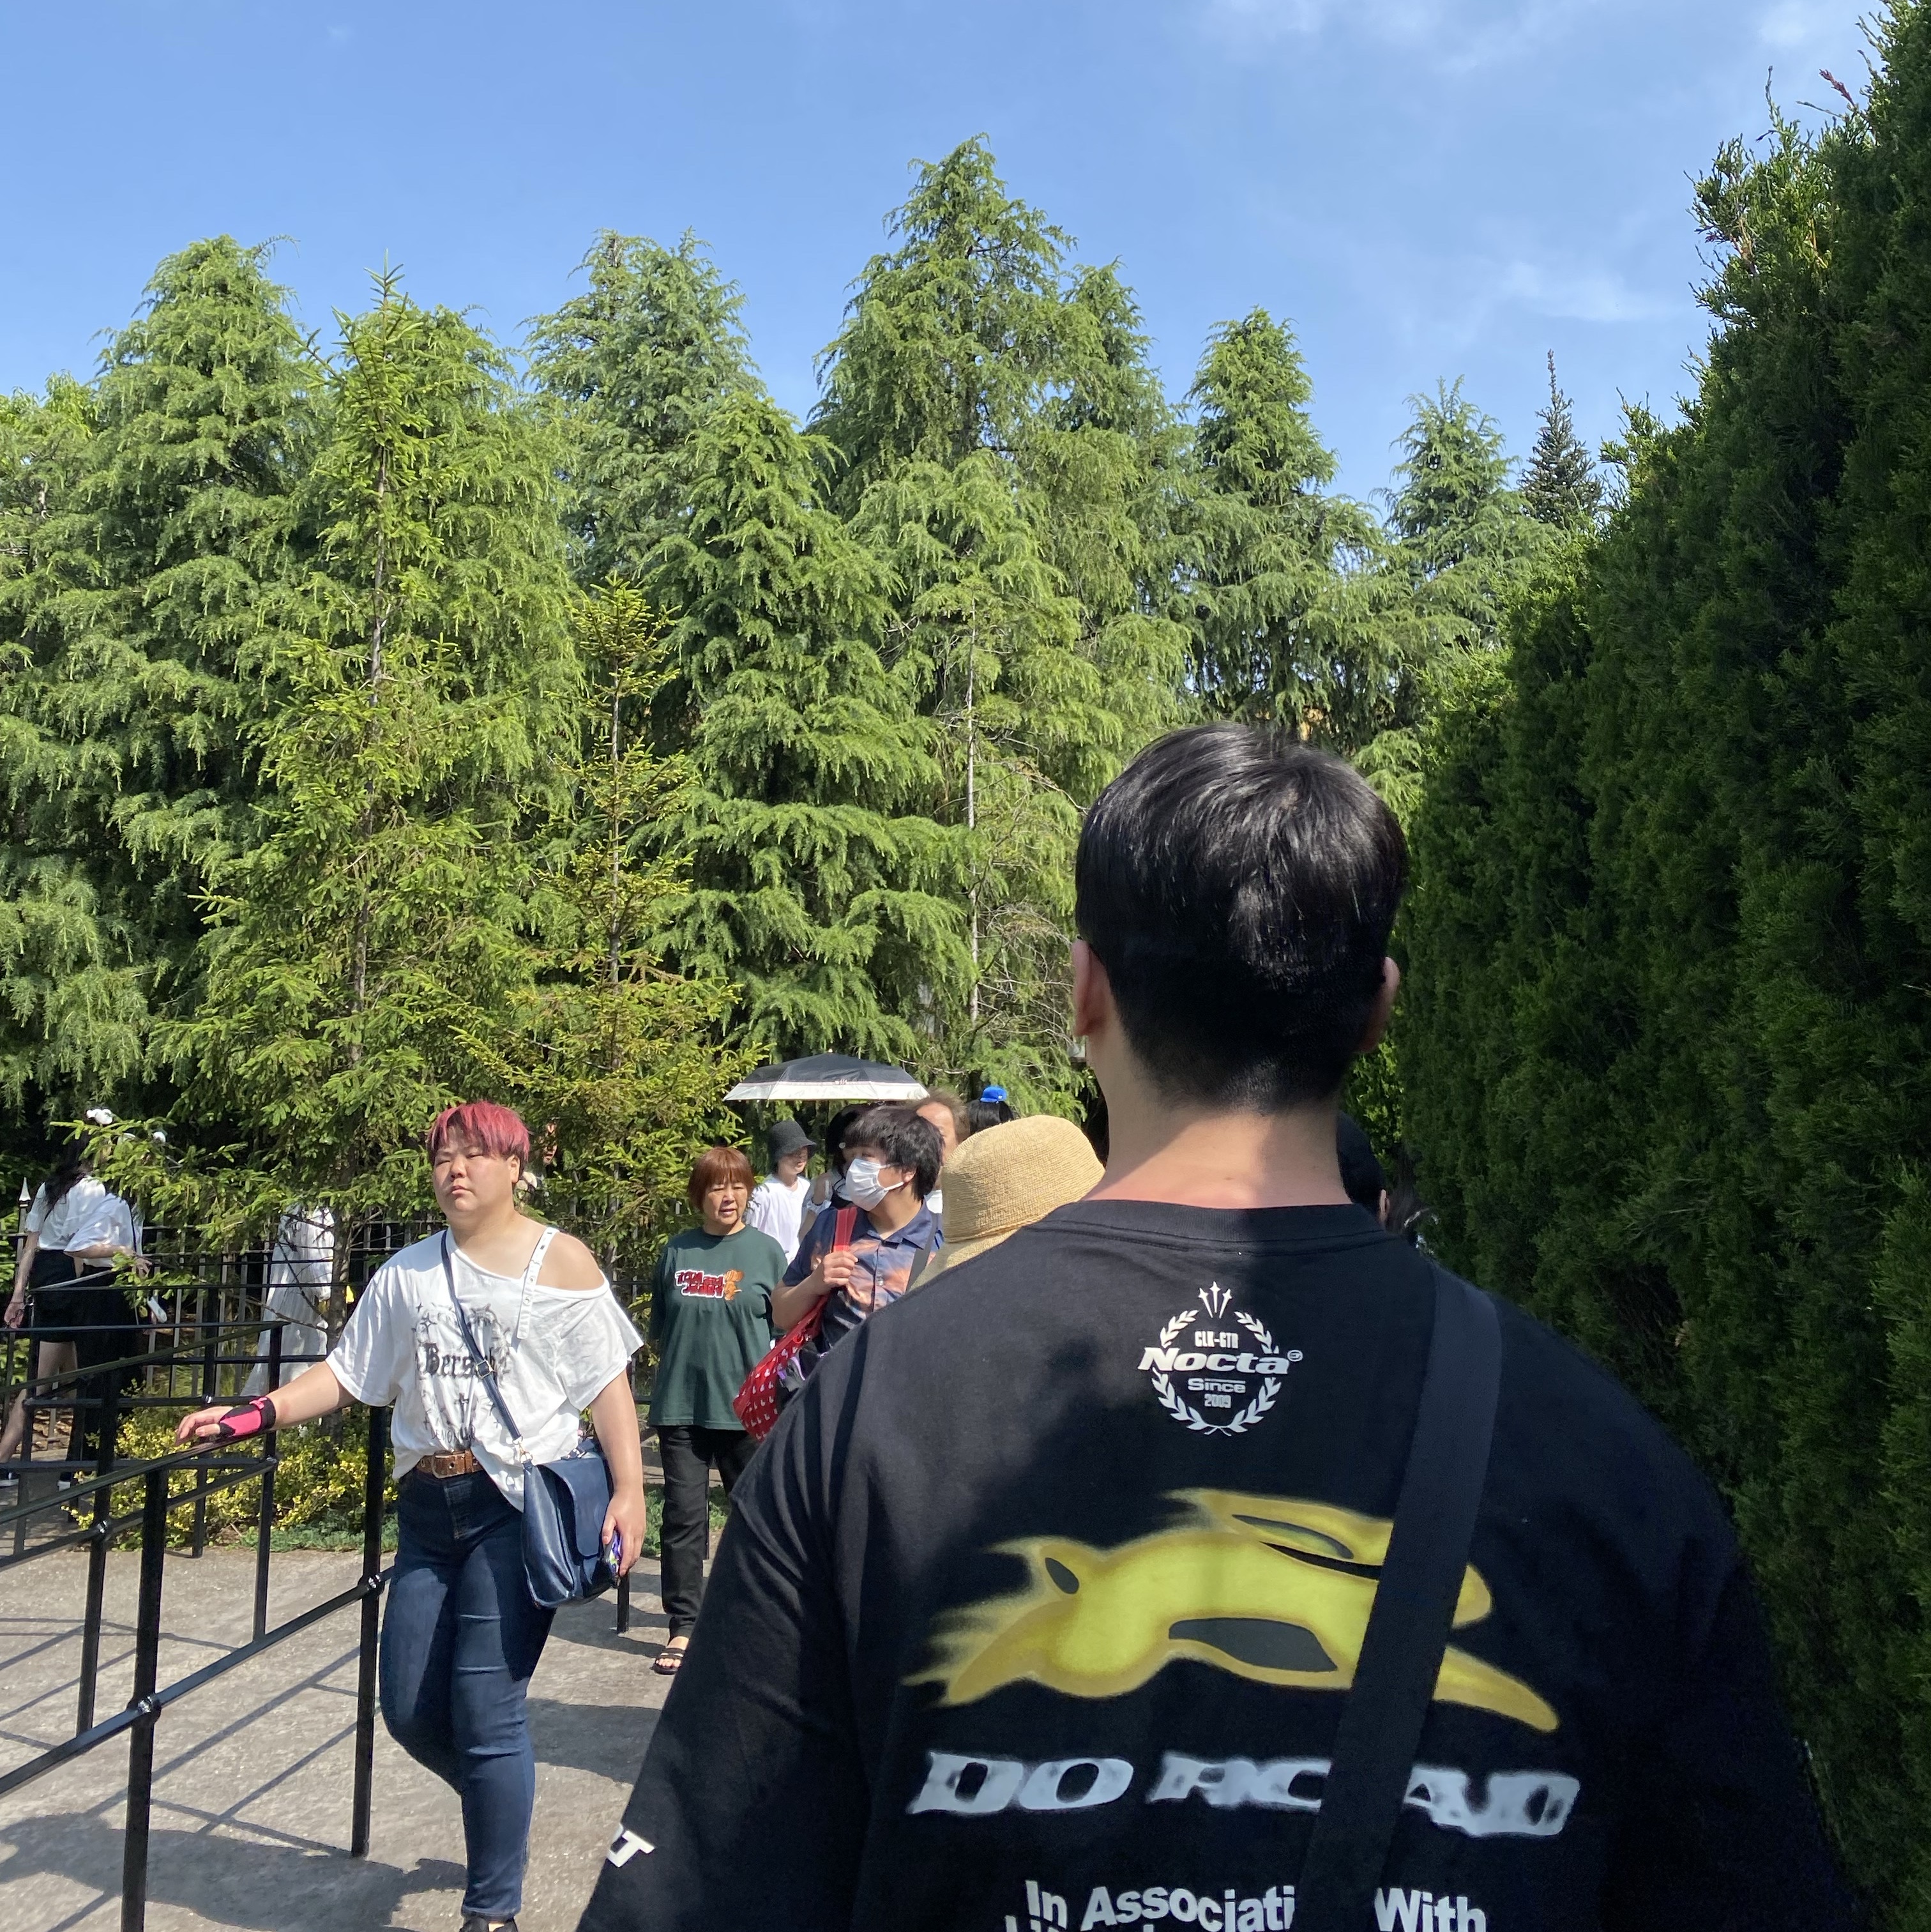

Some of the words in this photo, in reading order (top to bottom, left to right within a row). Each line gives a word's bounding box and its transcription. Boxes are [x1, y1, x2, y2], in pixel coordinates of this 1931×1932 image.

[1187, 1378, 1245, 1393] Since
[1025, 1880, 1067, 1929] In
[1080, 1885, 1296, 1932] Associati
[1374, 1887, 1487, 1932] With
